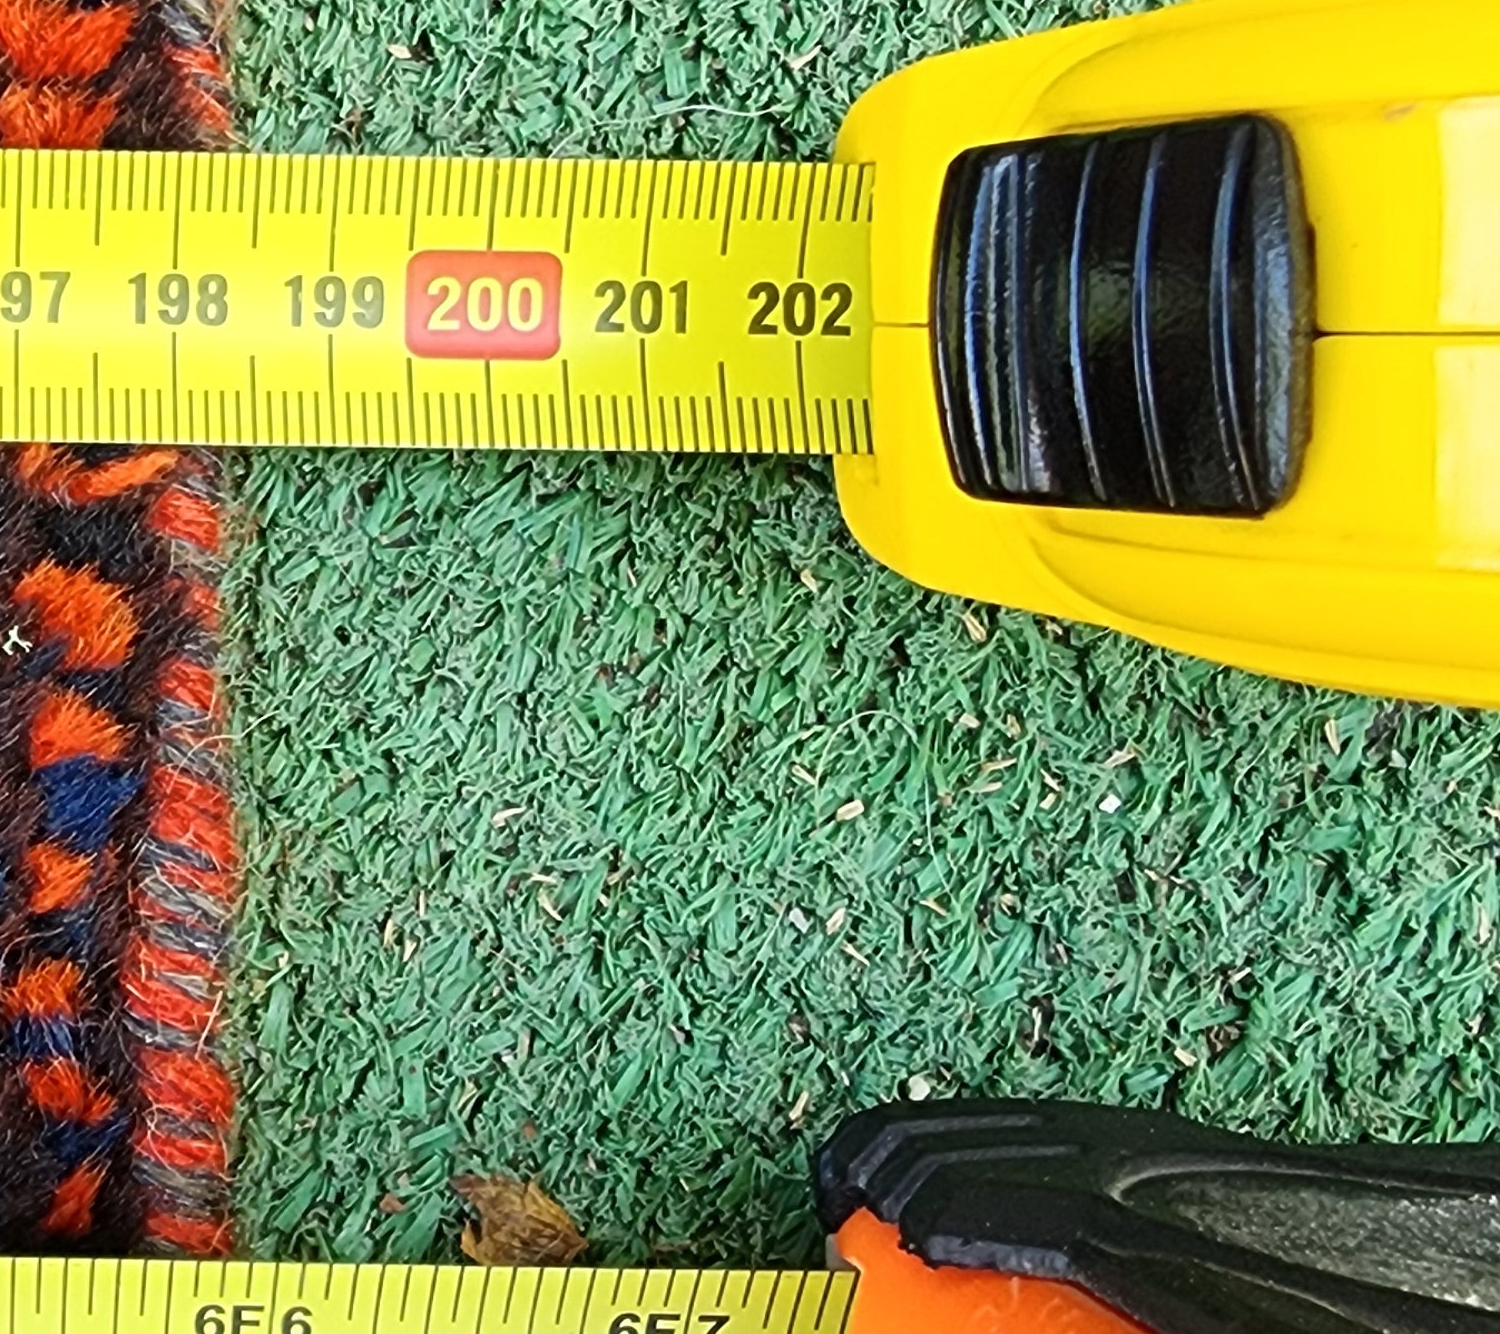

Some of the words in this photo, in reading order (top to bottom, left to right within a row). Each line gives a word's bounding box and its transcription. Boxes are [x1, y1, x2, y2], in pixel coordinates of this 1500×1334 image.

[128, 273, 228, 326] 198
[285, 275, 385, 328] 199
[426, 278, 543, 333] 200
[595, 280, 688, 334] 201
[747, 282, 853, 336] 202
